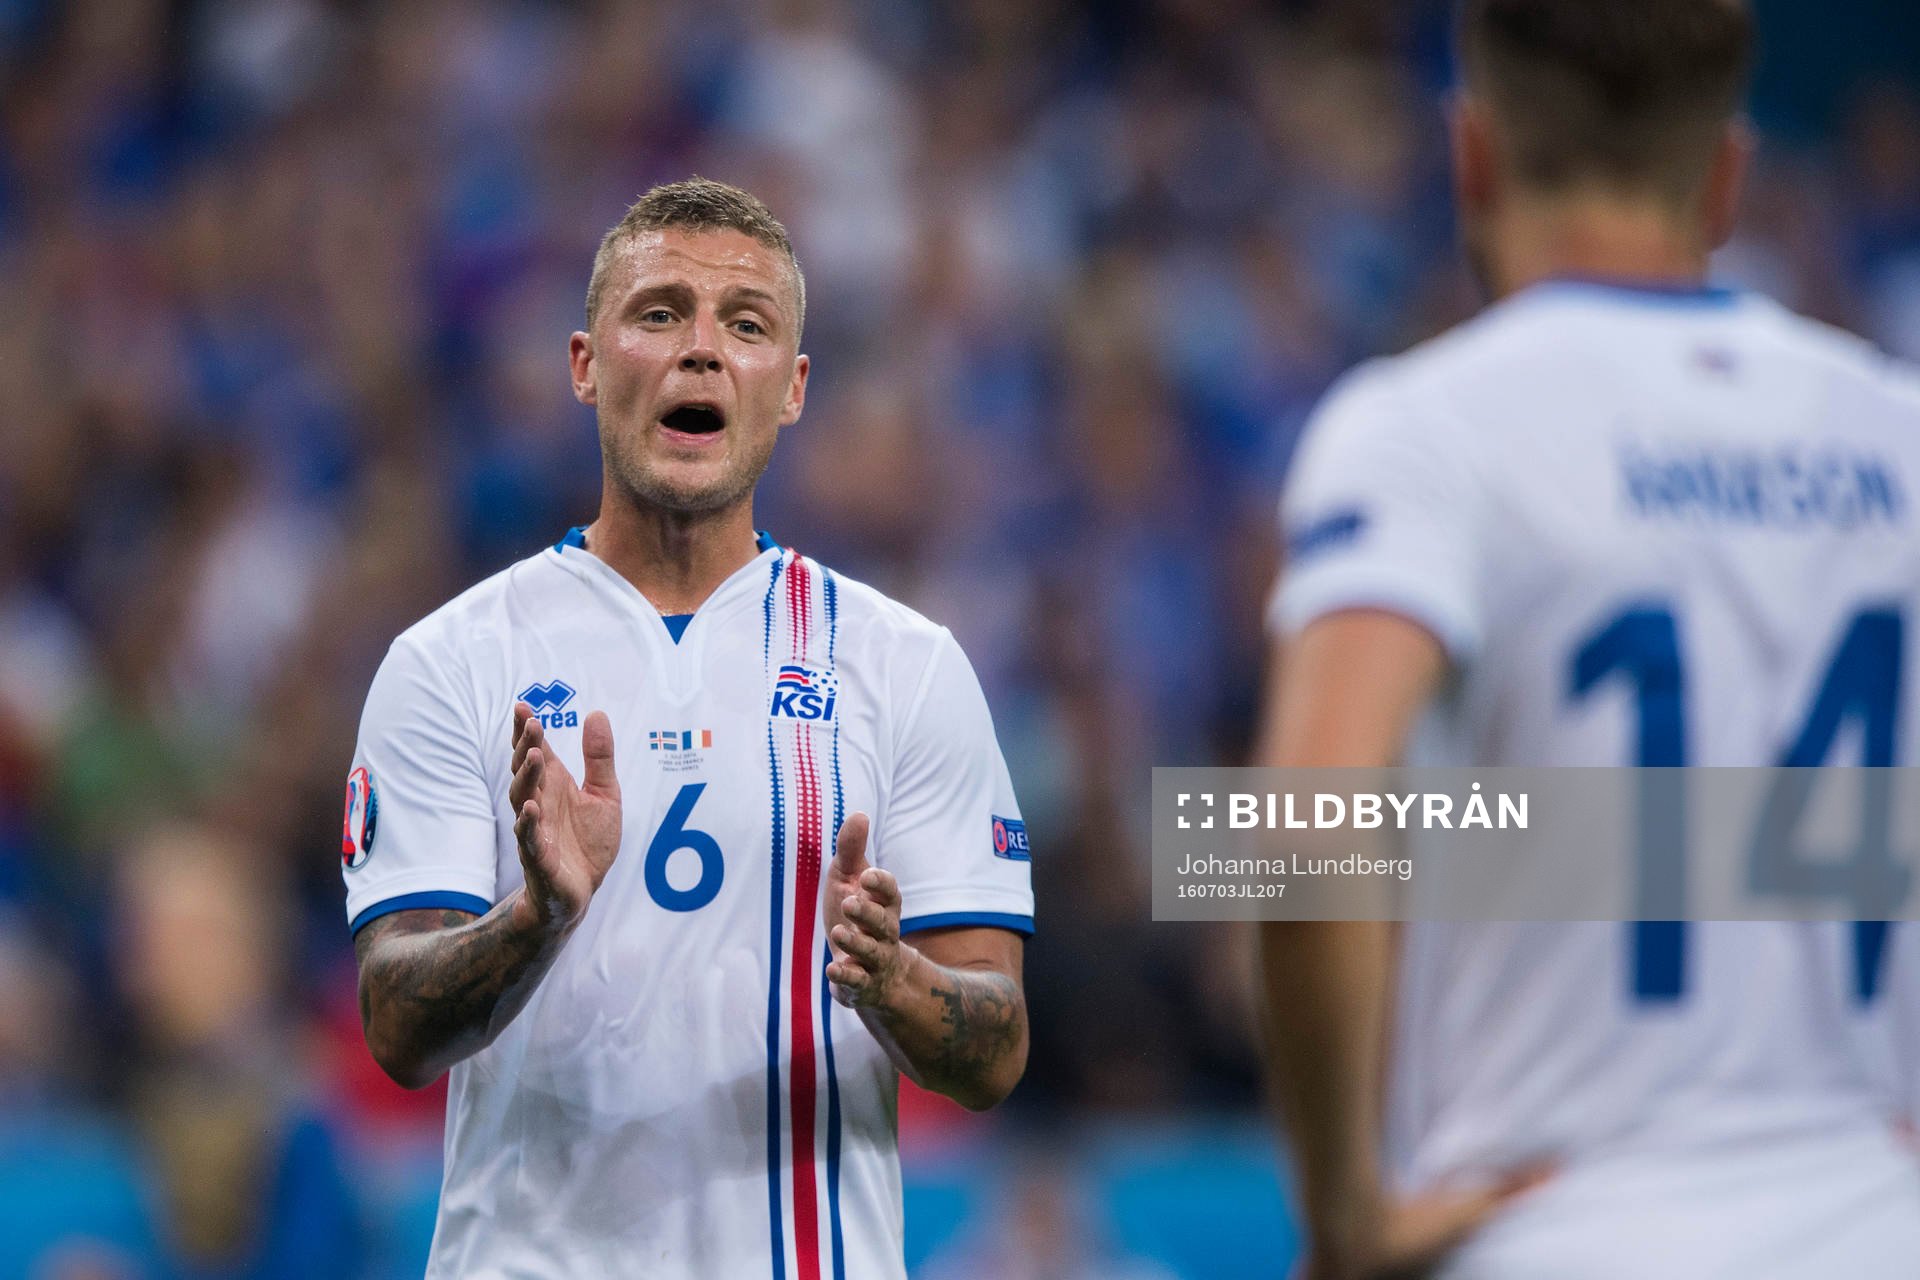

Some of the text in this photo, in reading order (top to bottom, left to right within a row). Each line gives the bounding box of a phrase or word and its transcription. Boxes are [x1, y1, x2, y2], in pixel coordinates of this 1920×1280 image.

[534, 711, 578, 730] rea
[644, 782, 725, 912] 6
[1566, 601, 1919, 1004] 14
